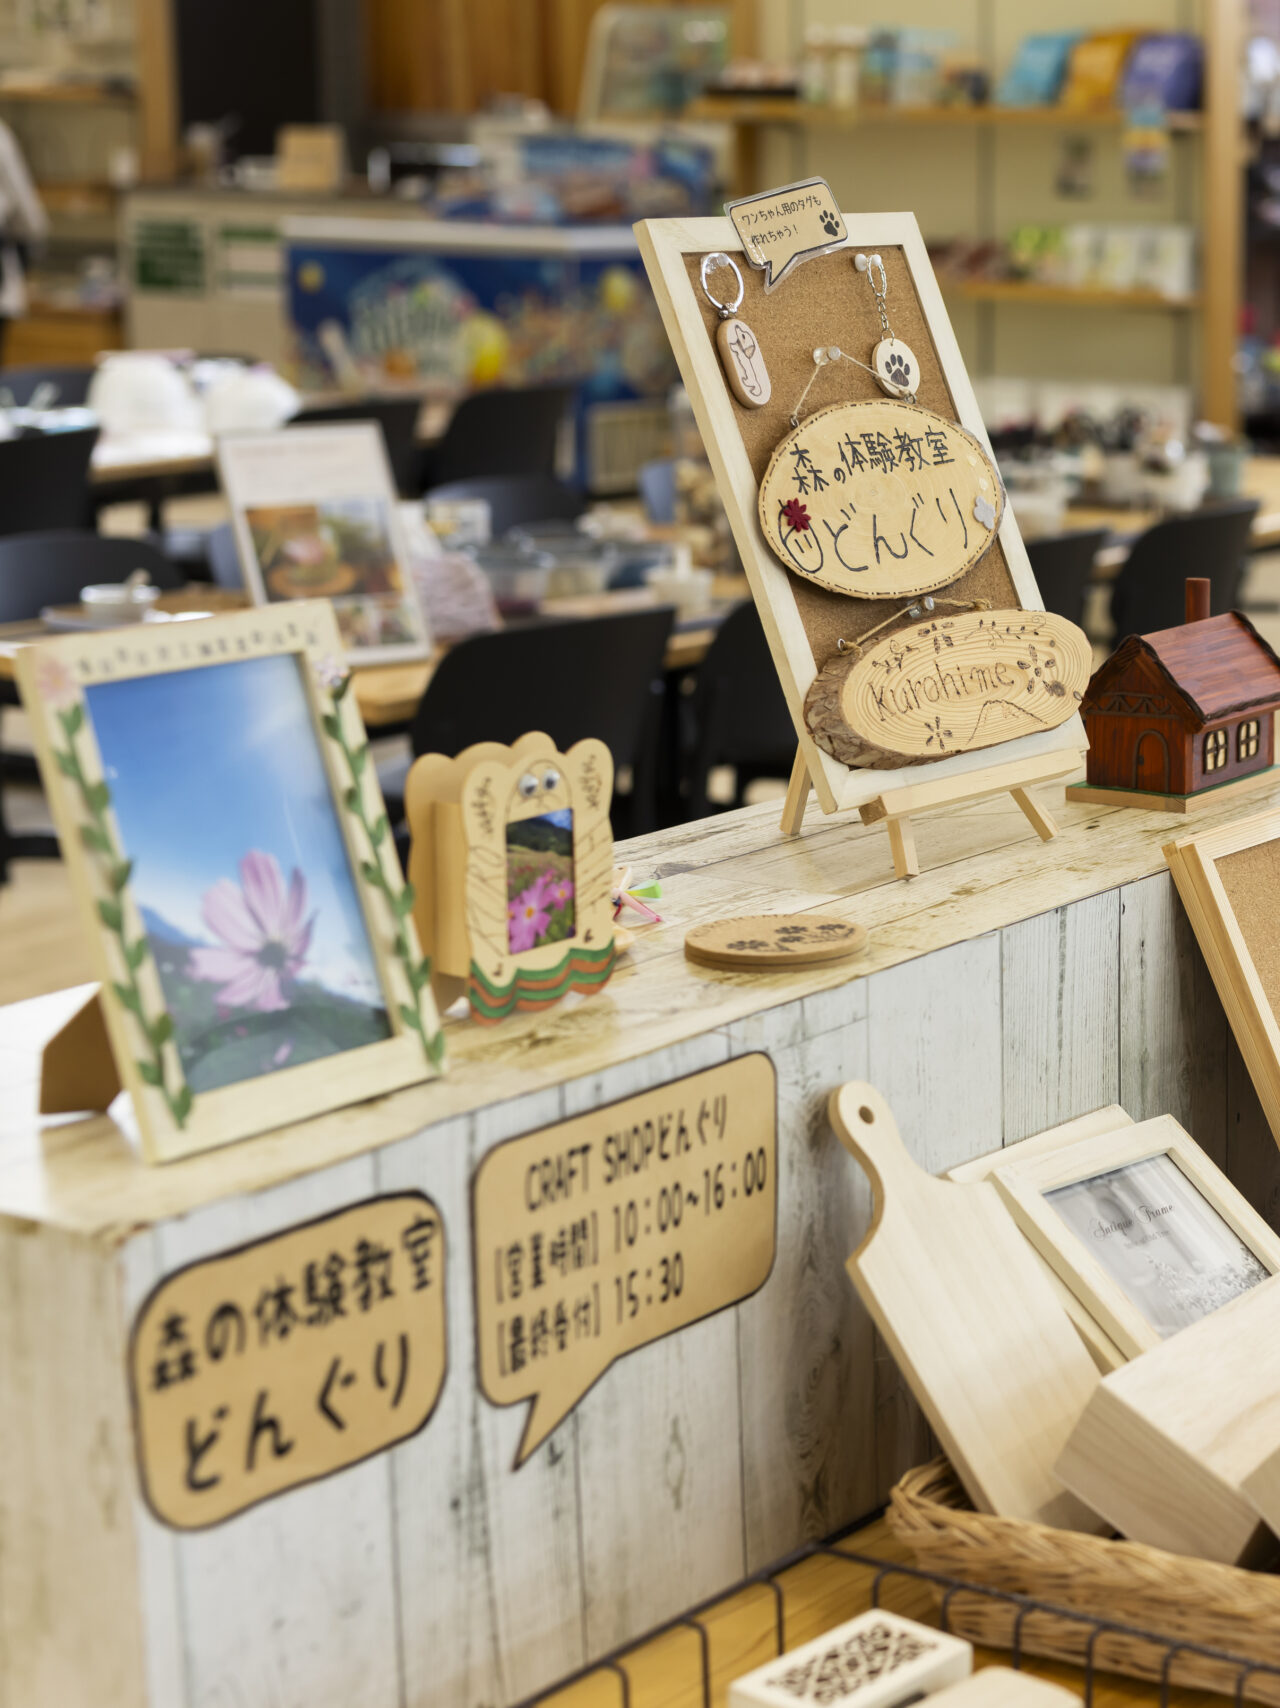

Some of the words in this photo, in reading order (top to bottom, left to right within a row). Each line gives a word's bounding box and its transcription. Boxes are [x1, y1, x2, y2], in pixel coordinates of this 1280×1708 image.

[741, 195, 822, 226] ワンちゃん用のタグも
[751, 224, 799, 248] 作れちゃう！
[789, 425, 956, 495] 森の体験教室
[822, 487, 968, 572] どんぐり
[523, 1142, 593, 1213] CRAFT
[601, 1094, 728, 1185] SHOPどんぐり
[149, 1212, 438, 1392] 森の体験教室
[613, 1251, 685, 1327] 15:30
[184, 1330, 411, 1495] どんぐり
